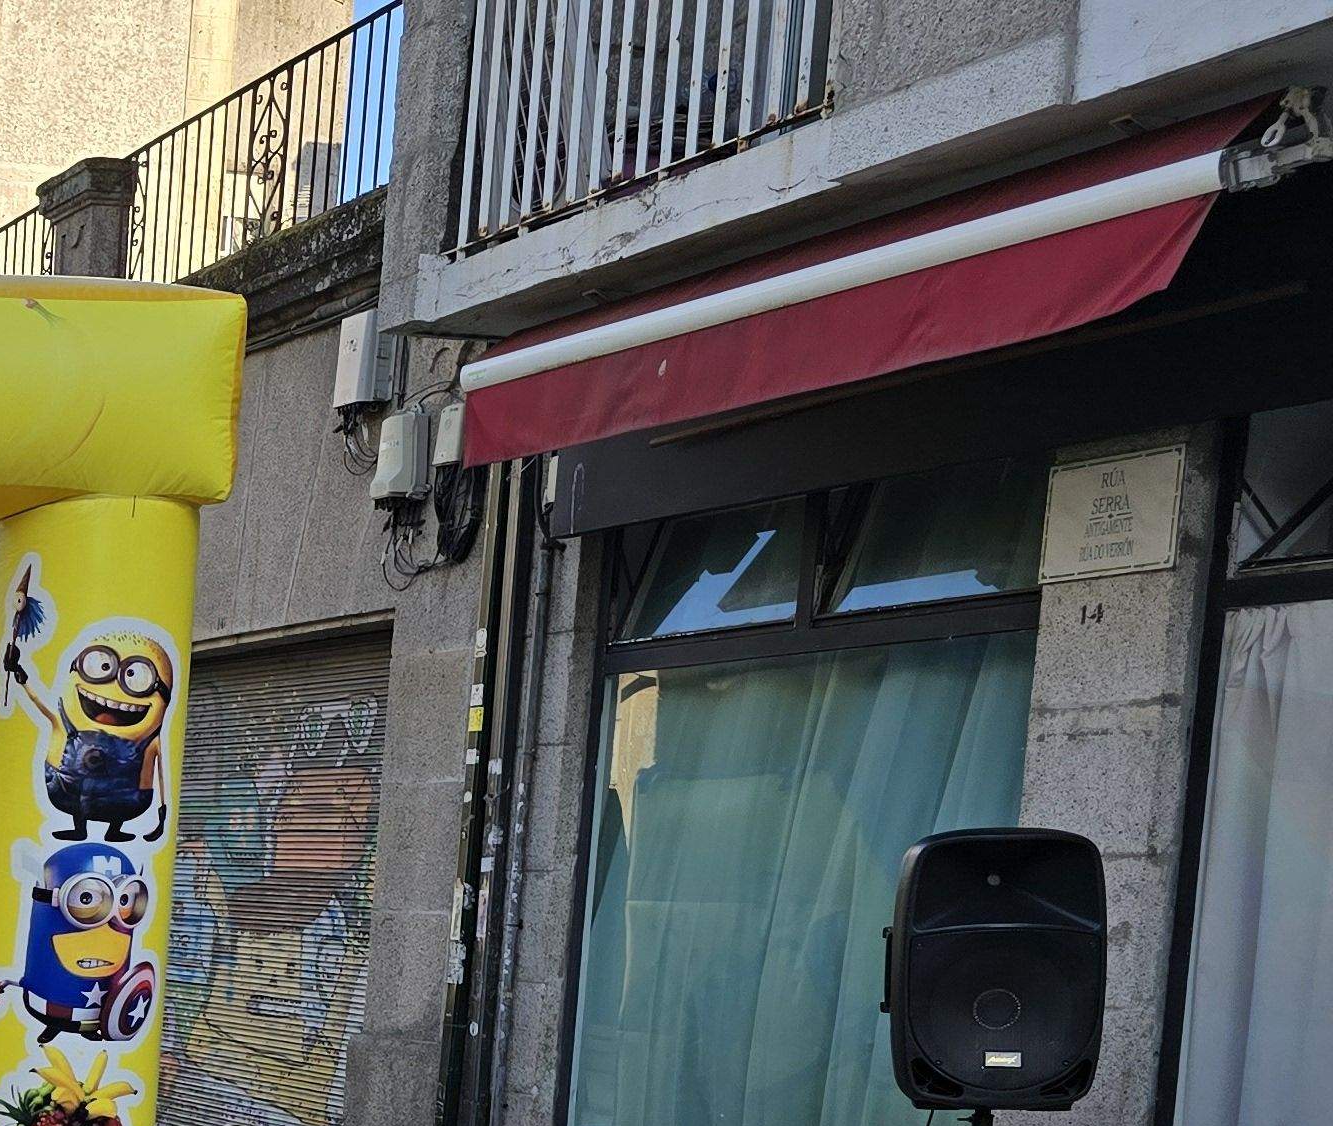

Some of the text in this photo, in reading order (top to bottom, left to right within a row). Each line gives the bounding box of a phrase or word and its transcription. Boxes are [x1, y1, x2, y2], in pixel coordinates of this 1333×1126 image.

[1101, 467, 1126, 488] RÚA
[1091, 494, 1130, 515] SERRA
[1081, 603, 1104, 625] 14
